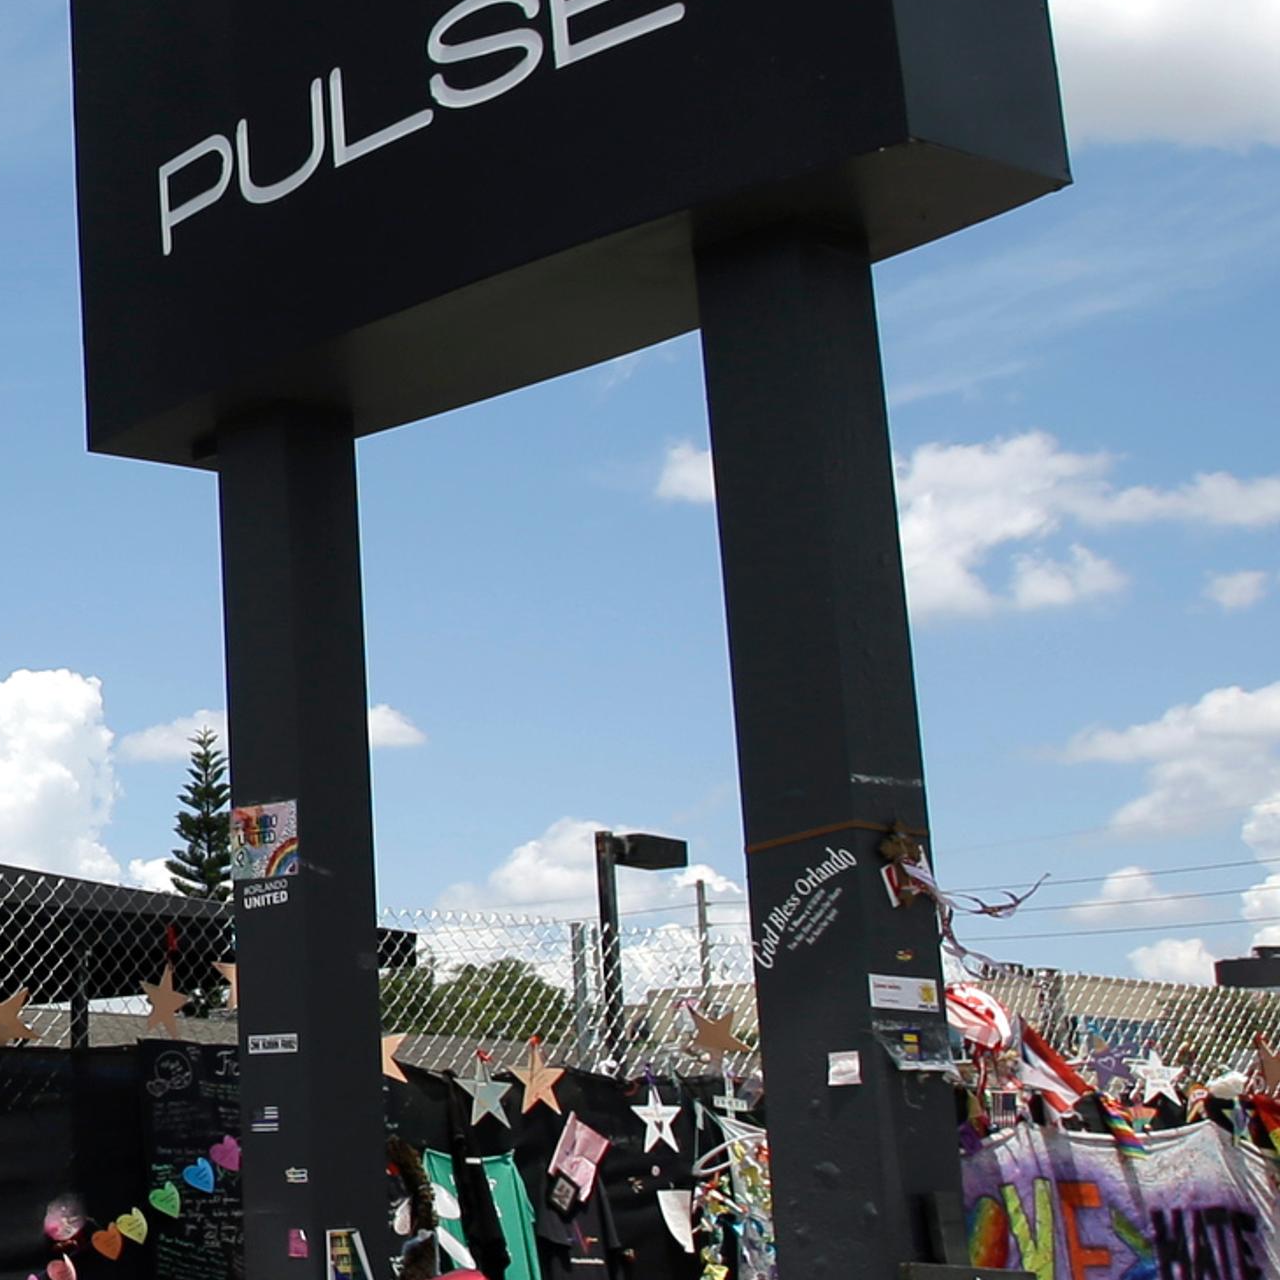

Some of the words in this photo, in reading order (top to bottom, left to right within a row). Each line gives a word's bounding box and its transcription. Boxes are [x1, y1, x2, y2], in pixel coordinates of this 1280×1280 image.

[243, 890, 289, 910] UNITED
[751, 922, 781, 969] God
[768, 894, 801, 932] Bless
[794, 846, 858, 896] Orlando
